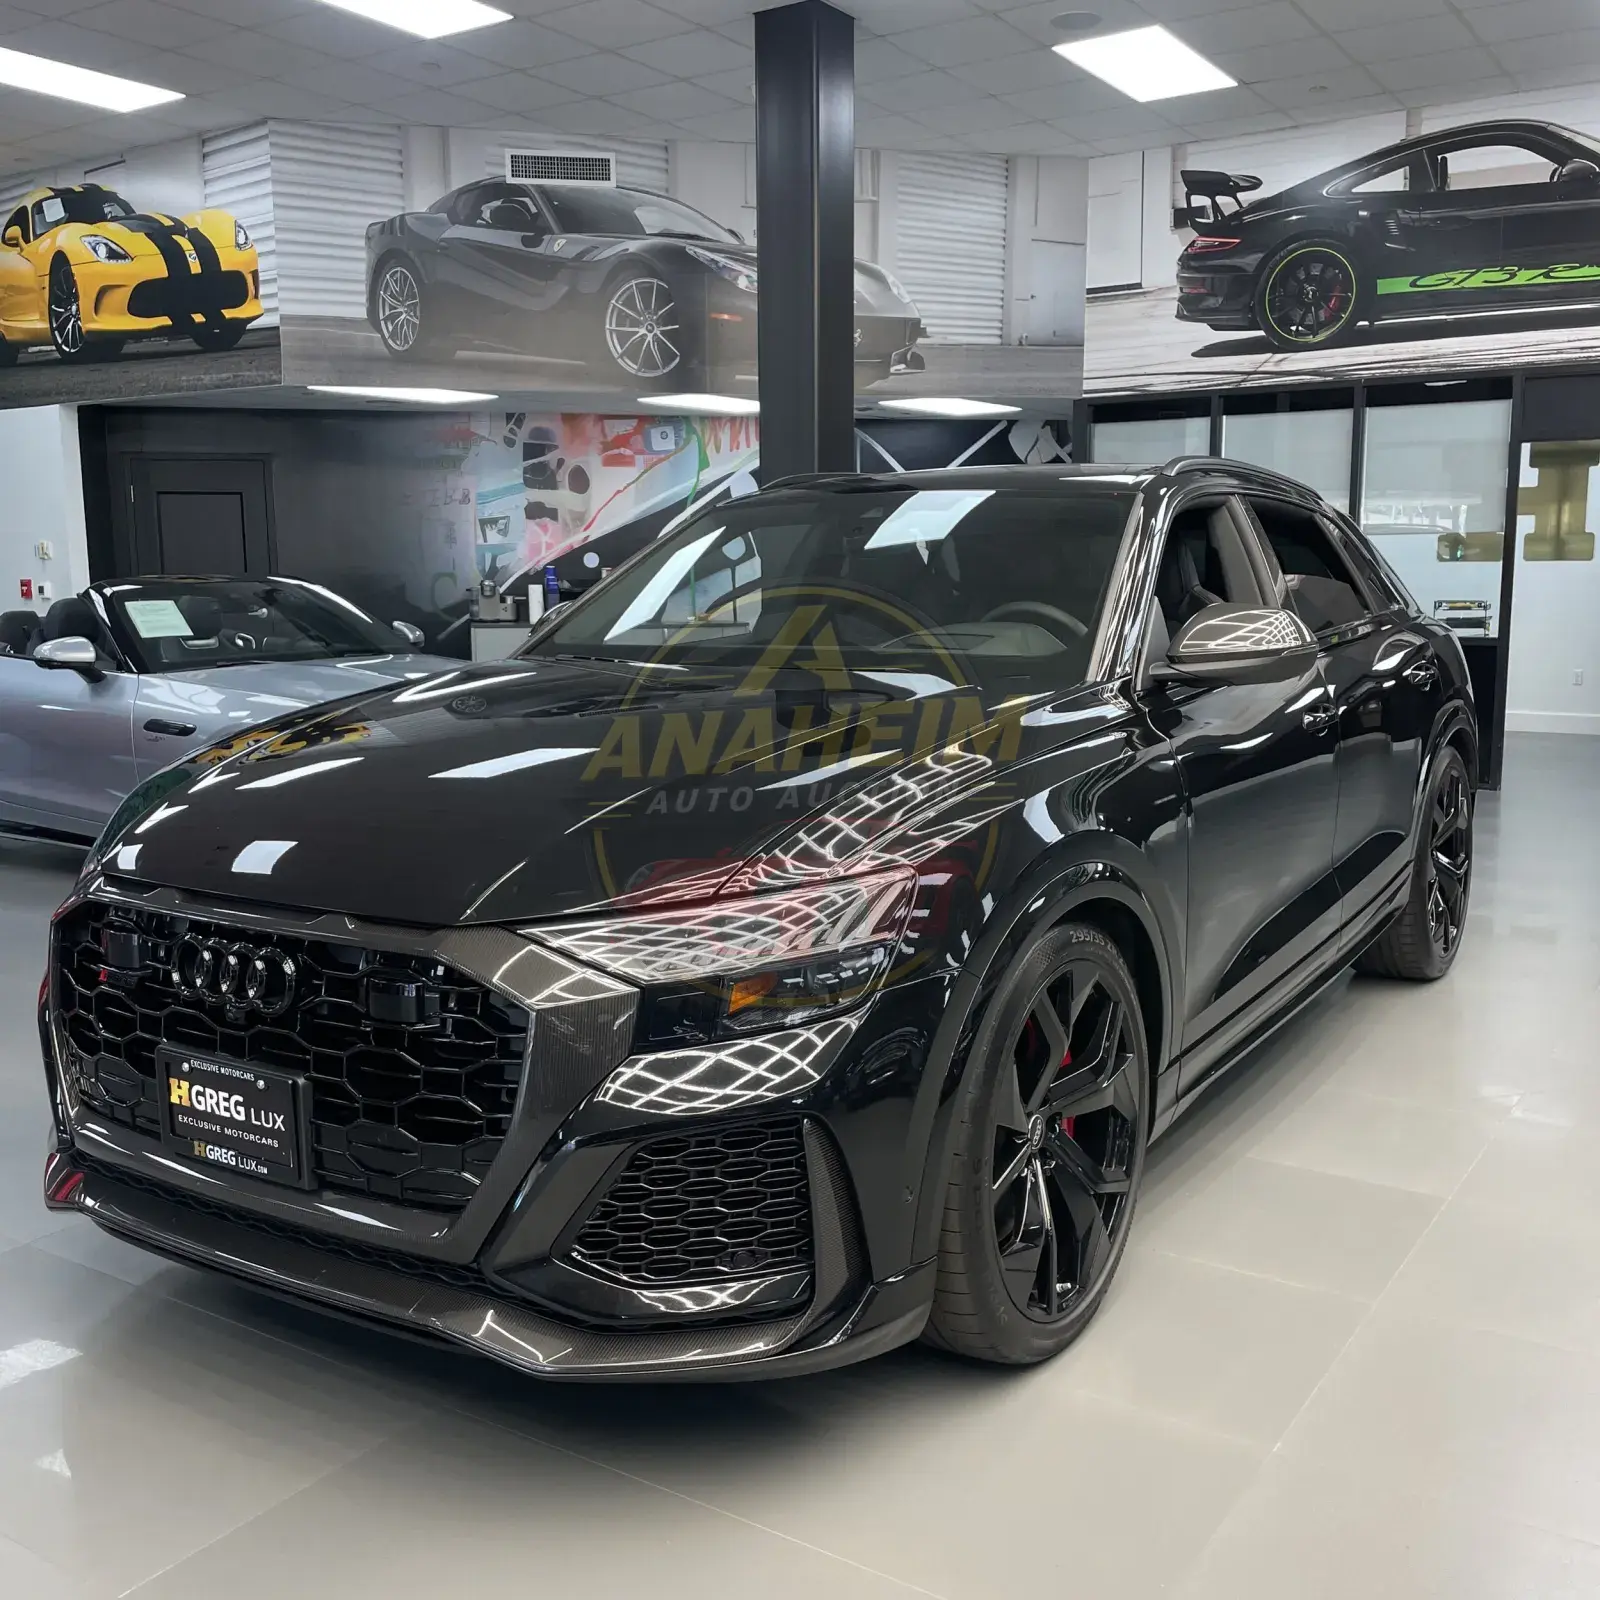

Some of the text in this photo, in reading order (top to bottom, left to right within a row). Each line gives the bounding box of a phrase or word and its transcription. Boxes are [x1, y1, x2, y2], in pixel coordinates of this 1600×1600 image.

[190, 1059, 255, 1082] EXCLUSIVE MOTORCARS
[169, 1078, 286, 1132] HGREG LUX
[178, 1114, 279, 1148] EXCLUSIVE MOTORCARS
[193, 1140, 236, 1166] HGREG
